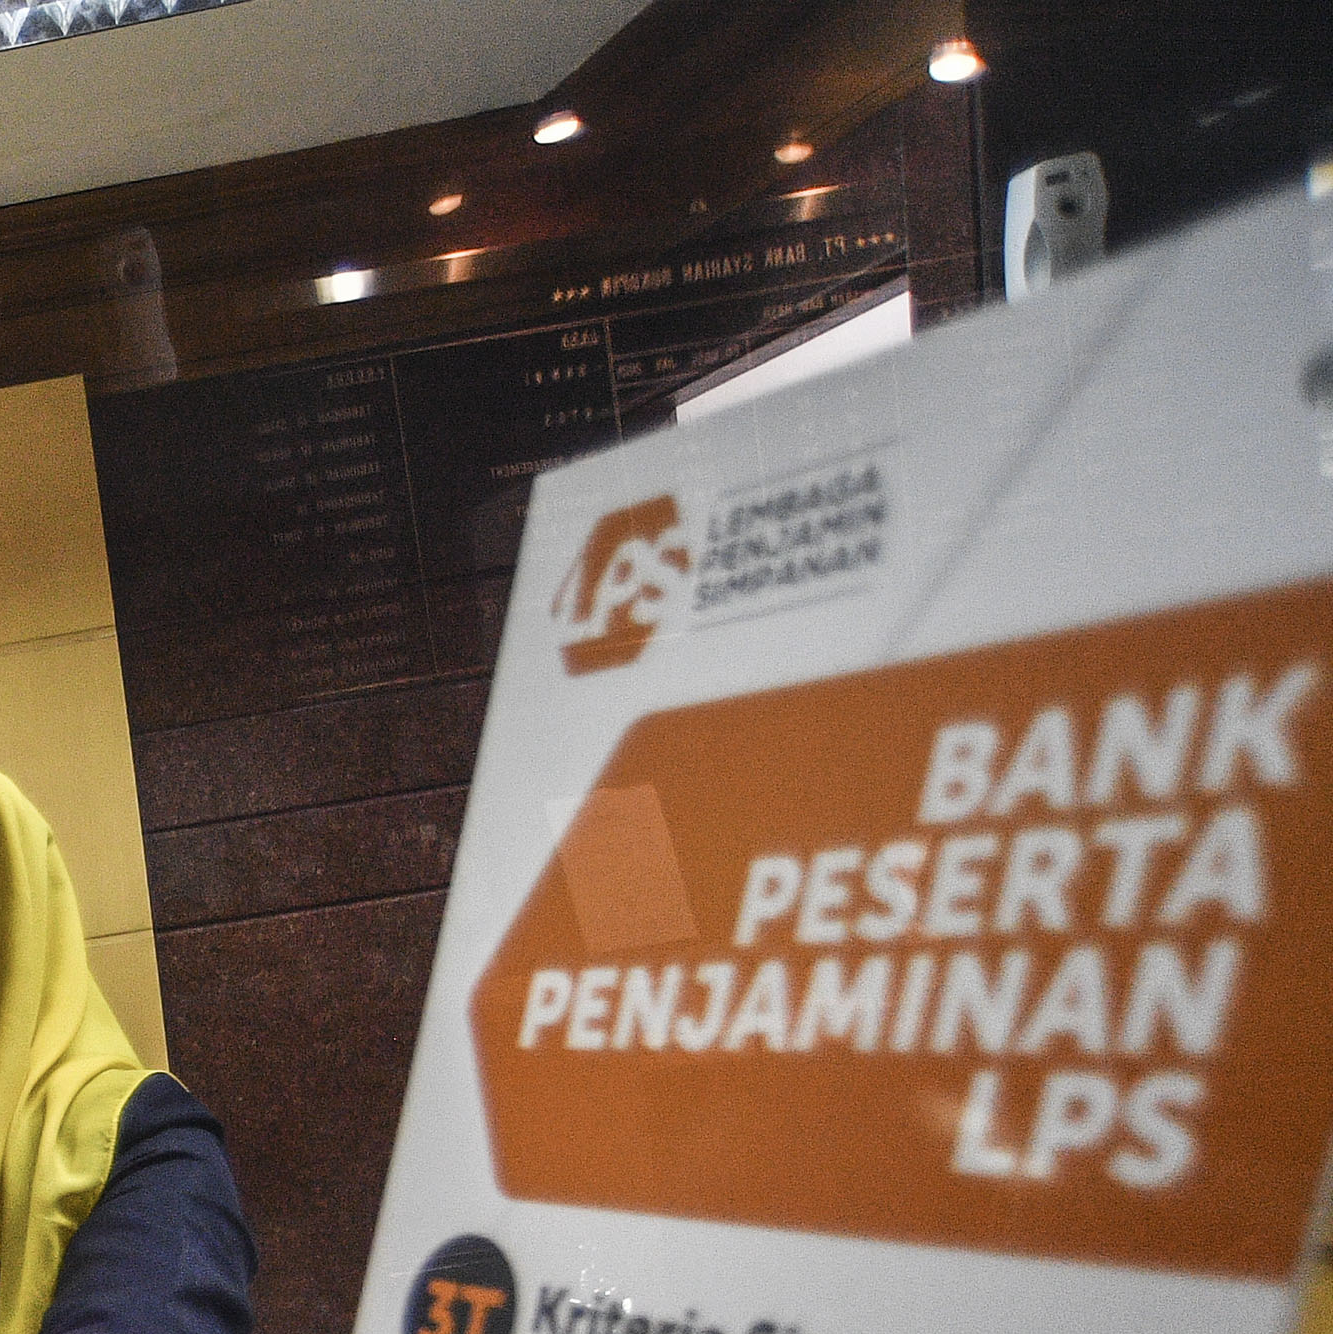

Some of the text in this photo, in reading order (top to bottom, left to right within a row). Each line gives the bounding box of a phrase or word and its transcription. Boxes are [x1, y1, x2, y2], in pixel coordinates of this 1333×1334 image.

[919, 659, 1323, 825] BANK
[735, 804, 1270, 948] PESERTA
[517, 936, 1246, 1058] PENJAMINAN
[949, 1067, 1207, 1191] LPS
